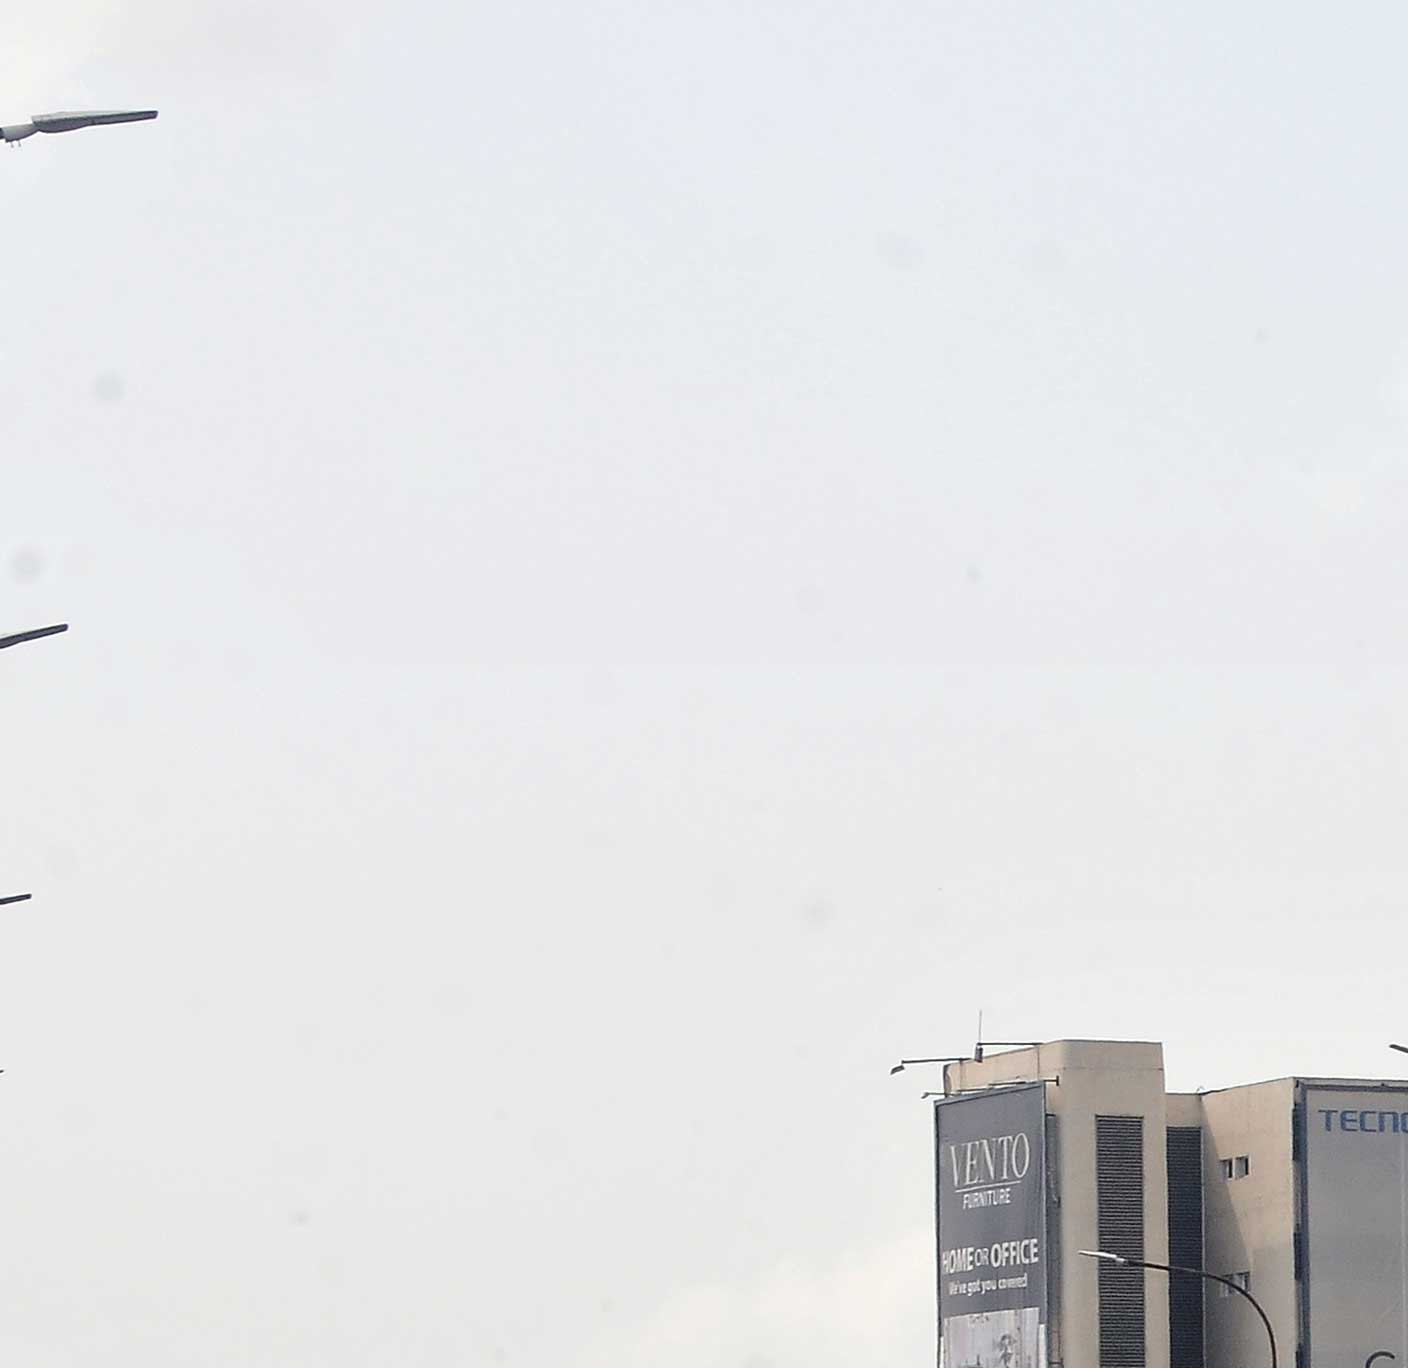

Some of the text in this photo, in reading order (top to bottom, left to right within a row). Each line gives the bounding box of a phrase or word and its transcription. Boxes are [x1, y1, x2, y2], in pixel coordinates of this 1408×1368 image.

[950, 1132, 1030, 1187] VENTO
[963, 1188, 1011, 1210] FURNITURE
[943, 1238, 1039, 1275] HOME OR OFFICE
[967, 1279, 981, 1297] got
[981, 1279, 997, 1295] you
[998, 1272, 1028, 1289] covered
